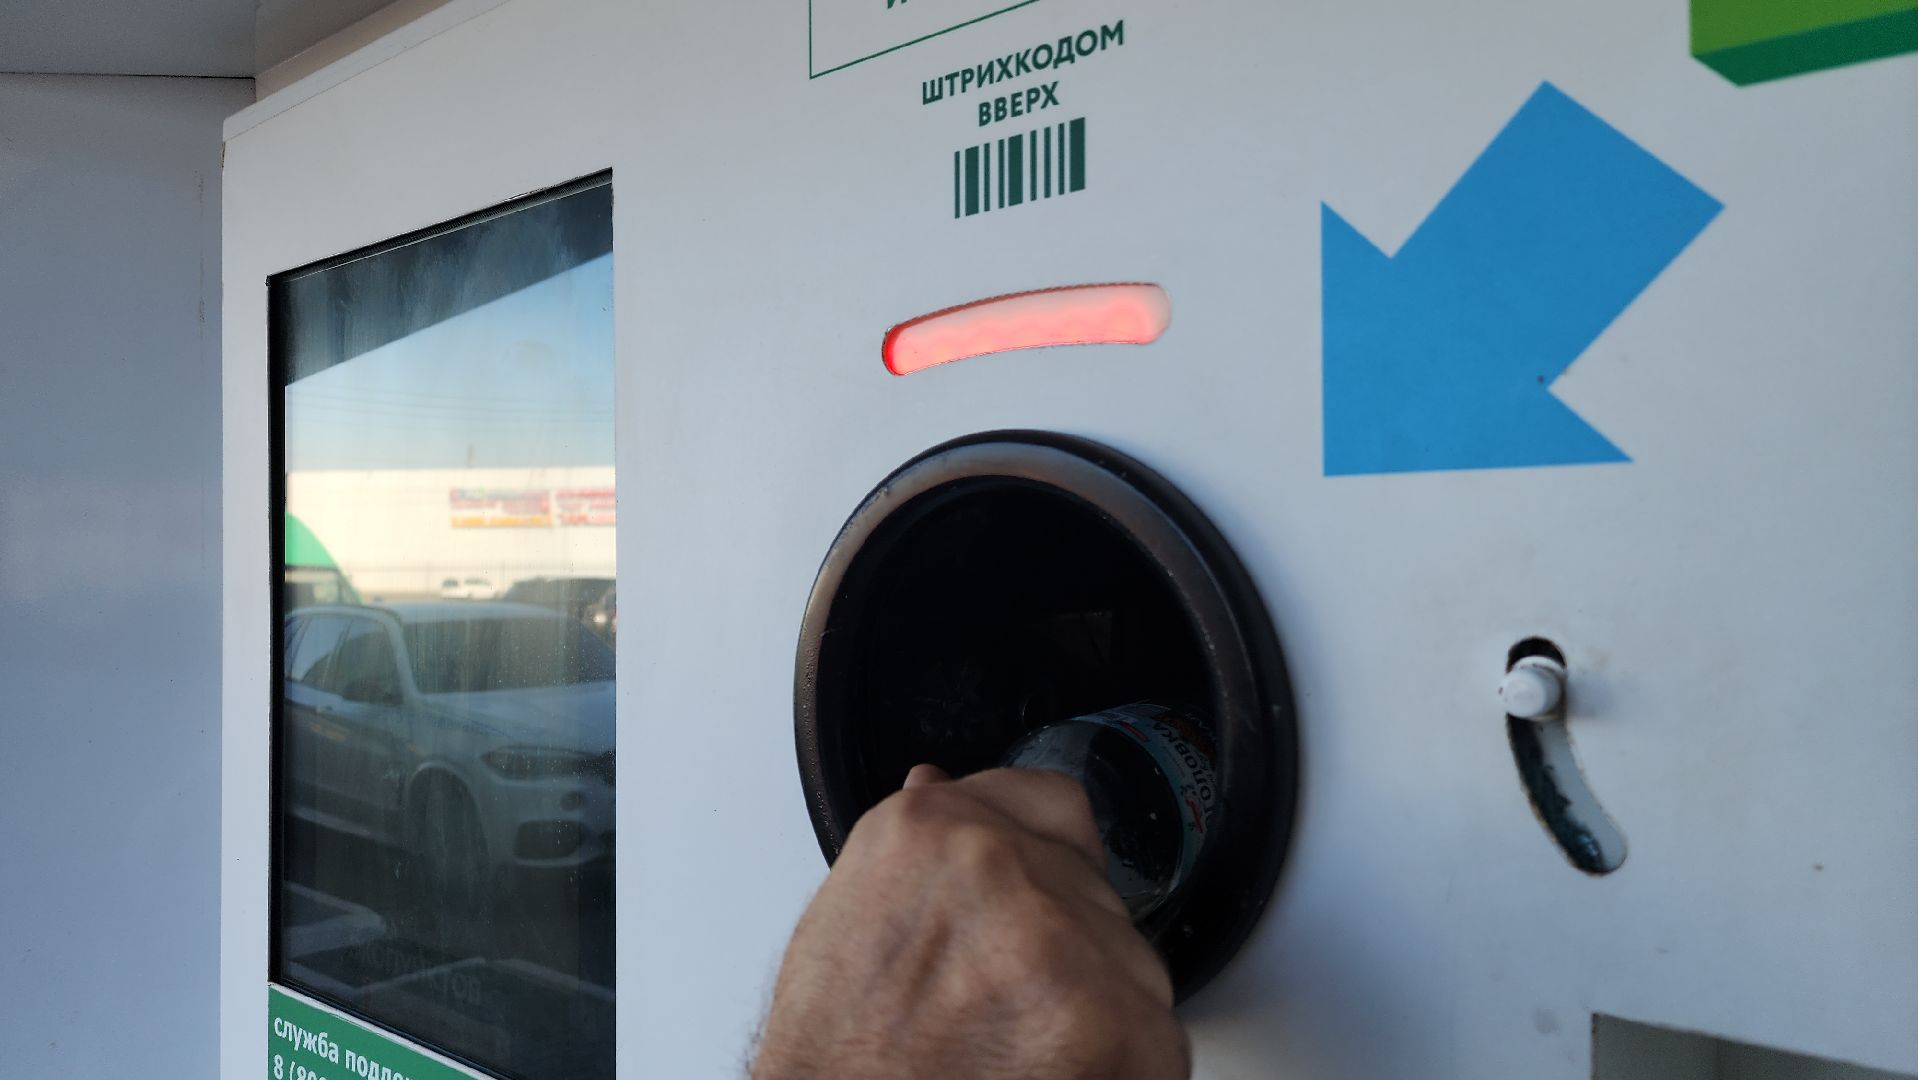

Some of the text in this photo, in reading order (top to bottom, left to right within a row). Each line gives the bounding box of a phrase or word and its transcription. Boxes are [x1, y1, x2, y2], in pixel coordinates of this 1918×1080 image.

[922, 19, 1124, 105] ШТРИХКОДОМ
[978, 81, 1060, 127] ВВЕРХ
[273, 1017, 339, 1065] служба
[273, 1054, 284, 1080] 8
